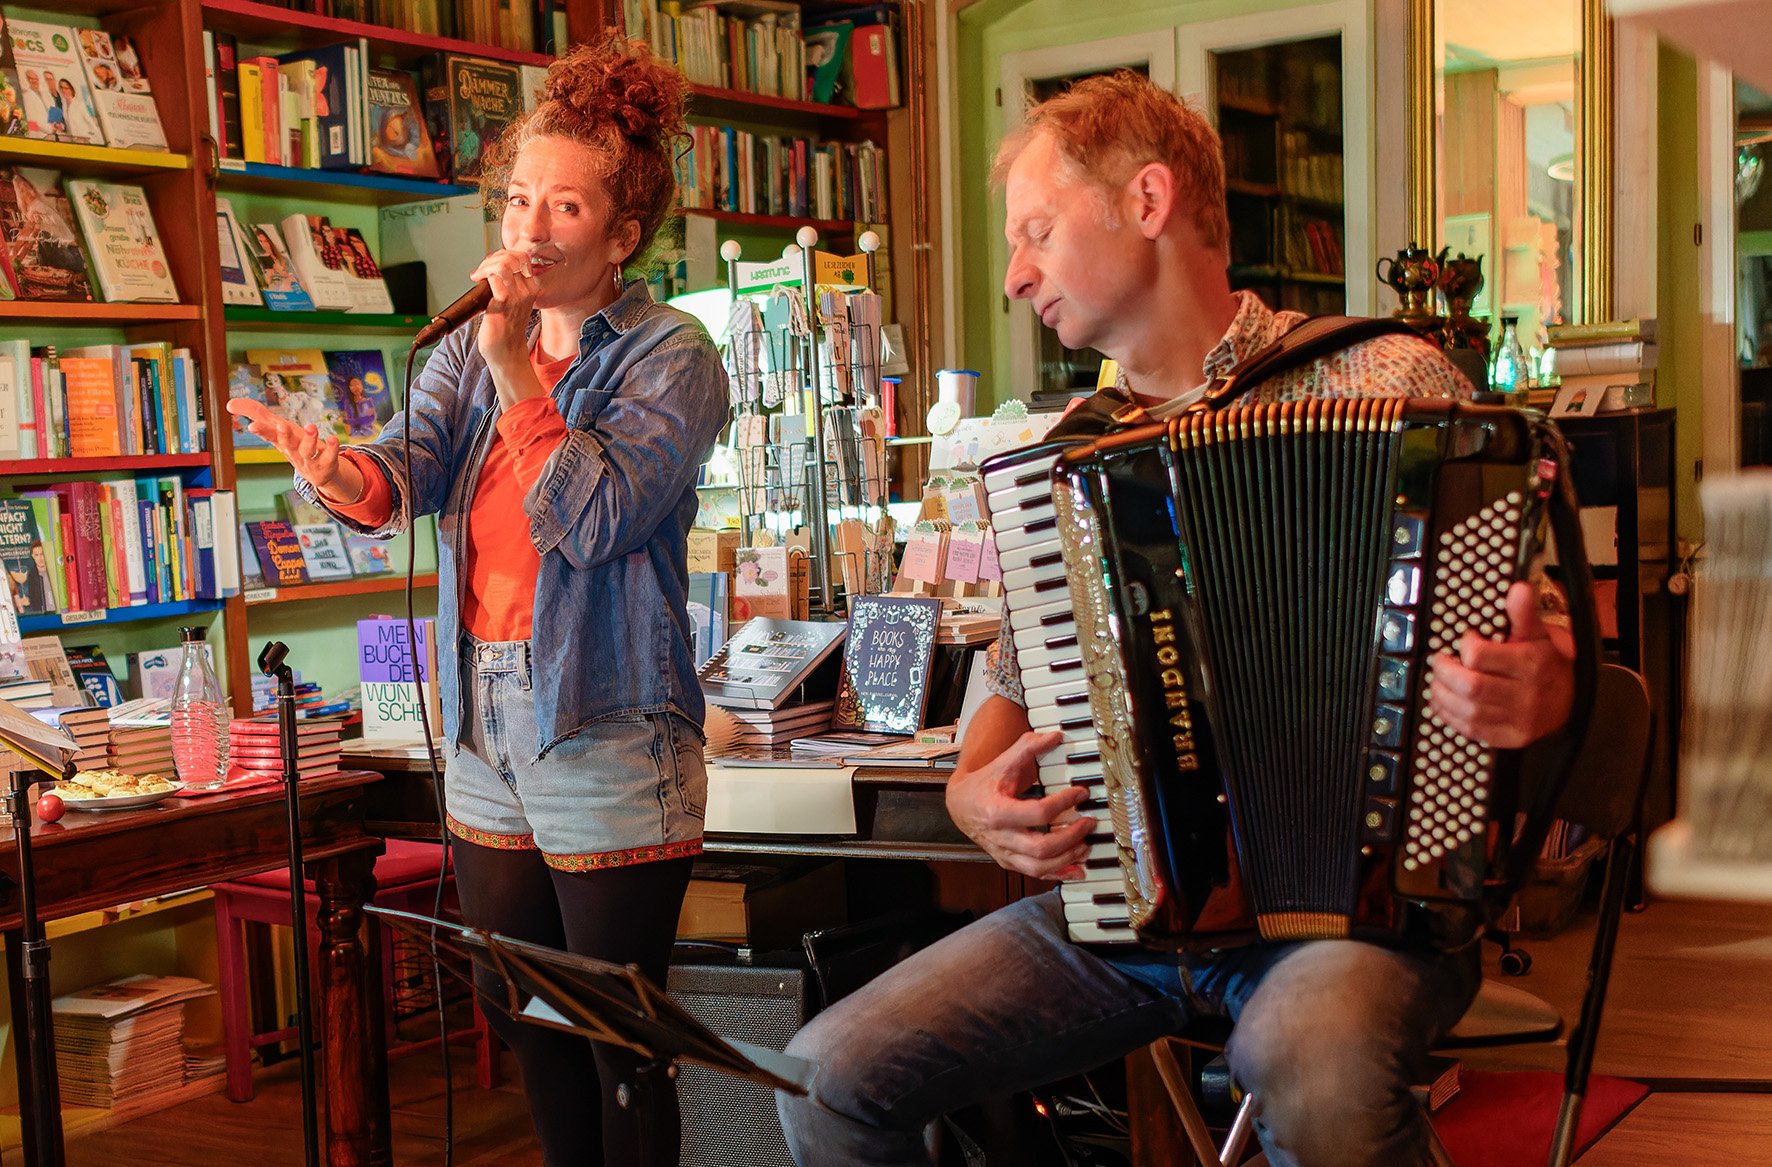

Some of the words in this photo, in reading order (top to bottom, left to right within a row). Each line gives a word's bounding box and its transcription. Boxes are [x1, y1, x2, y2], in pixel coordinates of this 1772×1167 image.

[0, 533, 31, 545] LTERN?
[378, 625, 424, 645] MEIN
[871, 630, 906, 649] BOOKS
[869, 654, 902, 670] HAPPY
[389, 664, 426, 683] DER
[865, 670, 898, 687] PLACE
[365, 683, 411, 702] WÜN
[1149, 608, 1200, 772] BRANDONI
